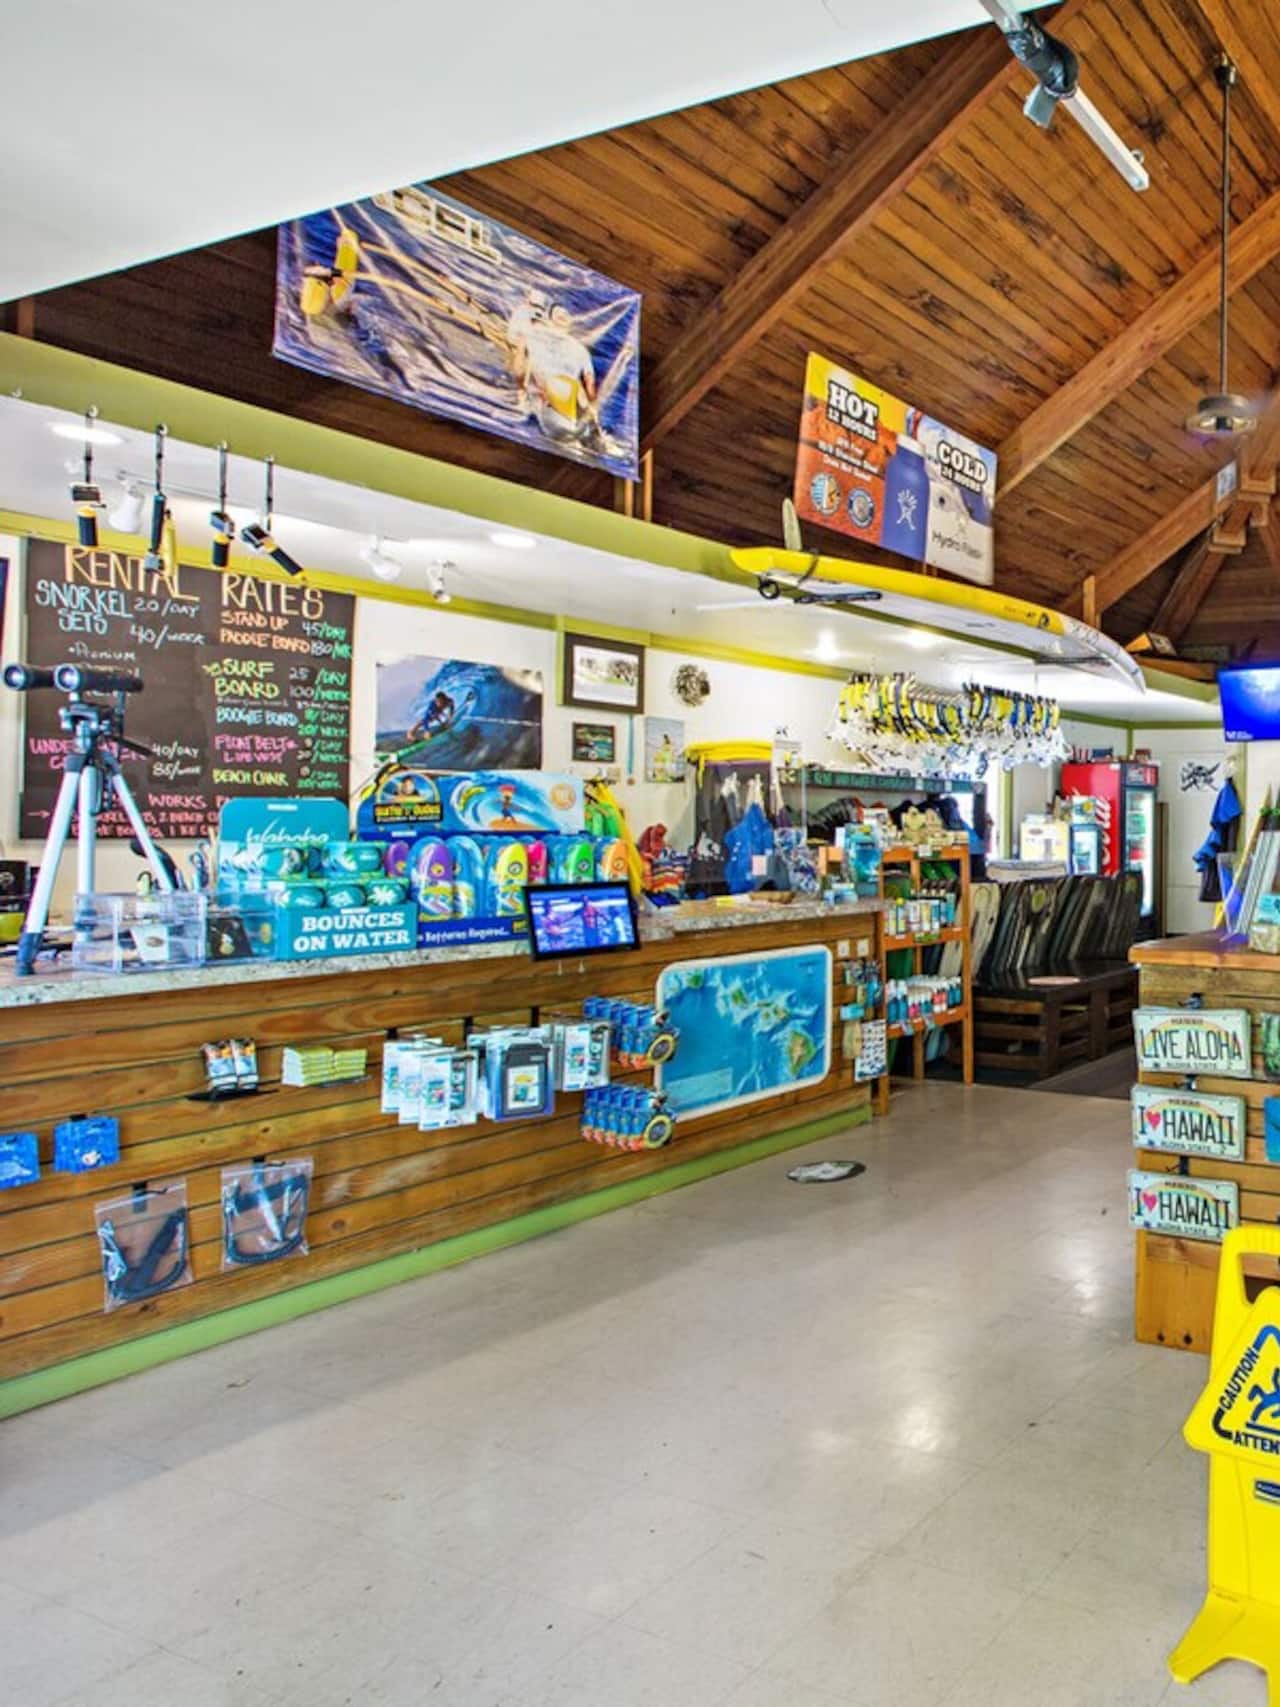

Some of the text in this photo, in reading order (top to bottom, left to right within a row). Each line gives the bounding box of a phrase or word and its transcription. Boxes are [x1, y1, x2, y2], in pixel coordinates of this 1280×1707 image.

[829, 383, 878, 427] HOT
[938, 442, 986, 482] COLD
[64, 544, 325, 620] RENTAL RATES
[35, 579, 134, 620] SNORKEL
[57, 608, 108, 635] SETS
[219, 608, 268, 628] STAND
[269, 614, 289, 631] UP
[219, 627, 272, 648] PADDLE
[271, 633, 311, 654] BOARD
[222, 657, 275, 679] SURF
[214, 676, 280, 699] BOARD
[147, 793, 208, 810] WORKS
[301, 911, 405, 933] BOUNCES
[292, 929, 411, 953] ON WATER
[1140, 1028, 1243, 1061] LIVE ALOHA
[1138, 1105, 1235, 1146] I HAWAII
[1134, 1187, 1231, 1229] I HAWAII
[1219, 1346, 1260, 1411] CAUTION
